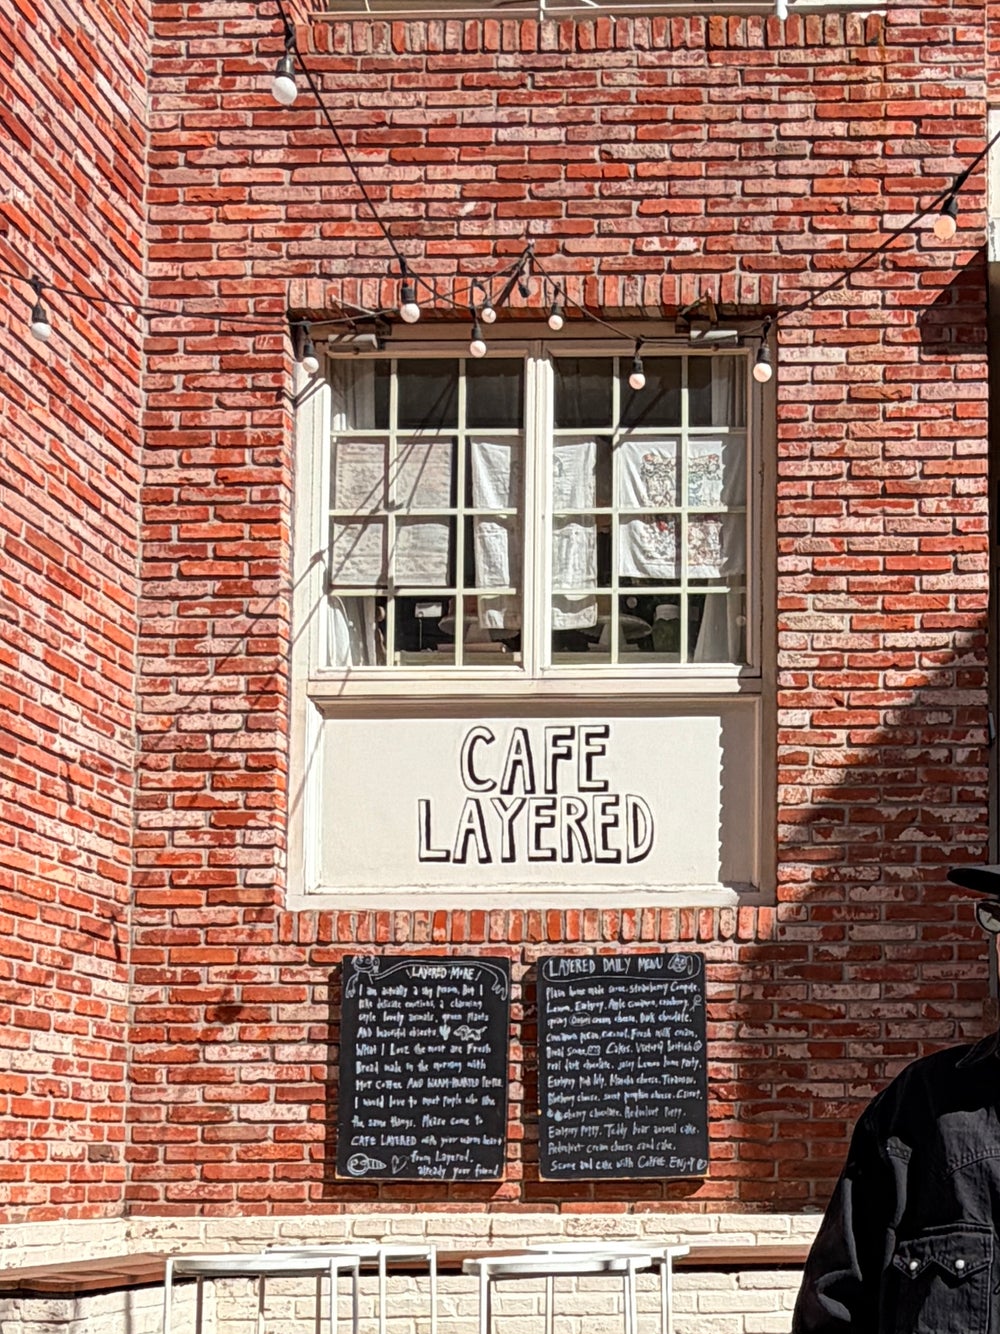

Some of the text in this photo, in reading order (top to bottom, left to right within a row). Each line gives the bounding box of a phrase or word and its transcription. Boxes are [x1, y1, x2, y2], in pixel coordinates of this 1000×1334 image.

[460, 724, 610, 795] CAFE
[418, 794, 655, 865] LAYERED
[549, 957, 664, 977] LAYERED DAILY MENU
[358, 999, 373, 1010] like
[450, 998, 483, 1010] charming
[383, 1010, 405, 1027] lovely
[376, 1026, 406, 1040] beautiful
[414, 1043, 427, 1055] the
[450, 1044, 464, 1054] are
[355, 1060, 380, 1074] Bread
[417, 1059, 430, 1072] the
[433, 1061, 463, 1073] morning
[466, 1059, 487, 1071] with
[354, 1096, 359, 1109] I
[362, 1095, 384, 1108] would
[388, 1094, 406, 1108] love
[408, 1095, 418, 1109] to
[351, 1114, 365, 1128] the
[368, 1118, 387, 1128] same
[390, 1115, 416, 1130] things.
[422, 1113, 447, 1128] Please
[603, 1121, 628, 1139] Teddy
[632, 1121, 650, 1136] bear
[380, 1134, 417, 1146] LAYERED
[440, 1136, 459, 1147] your
[460, 1137, 481, 1145] warm
[586, 1143, 609, 1154] cream
[610, 1139, 634, 1152] cheese
[410, 1149, 475, 1165] from Layered.
[579, 1156, 594, 1170] and
[616, 1156, 634, 1169] with
[417, 1164, 500, 1181] already your friend
